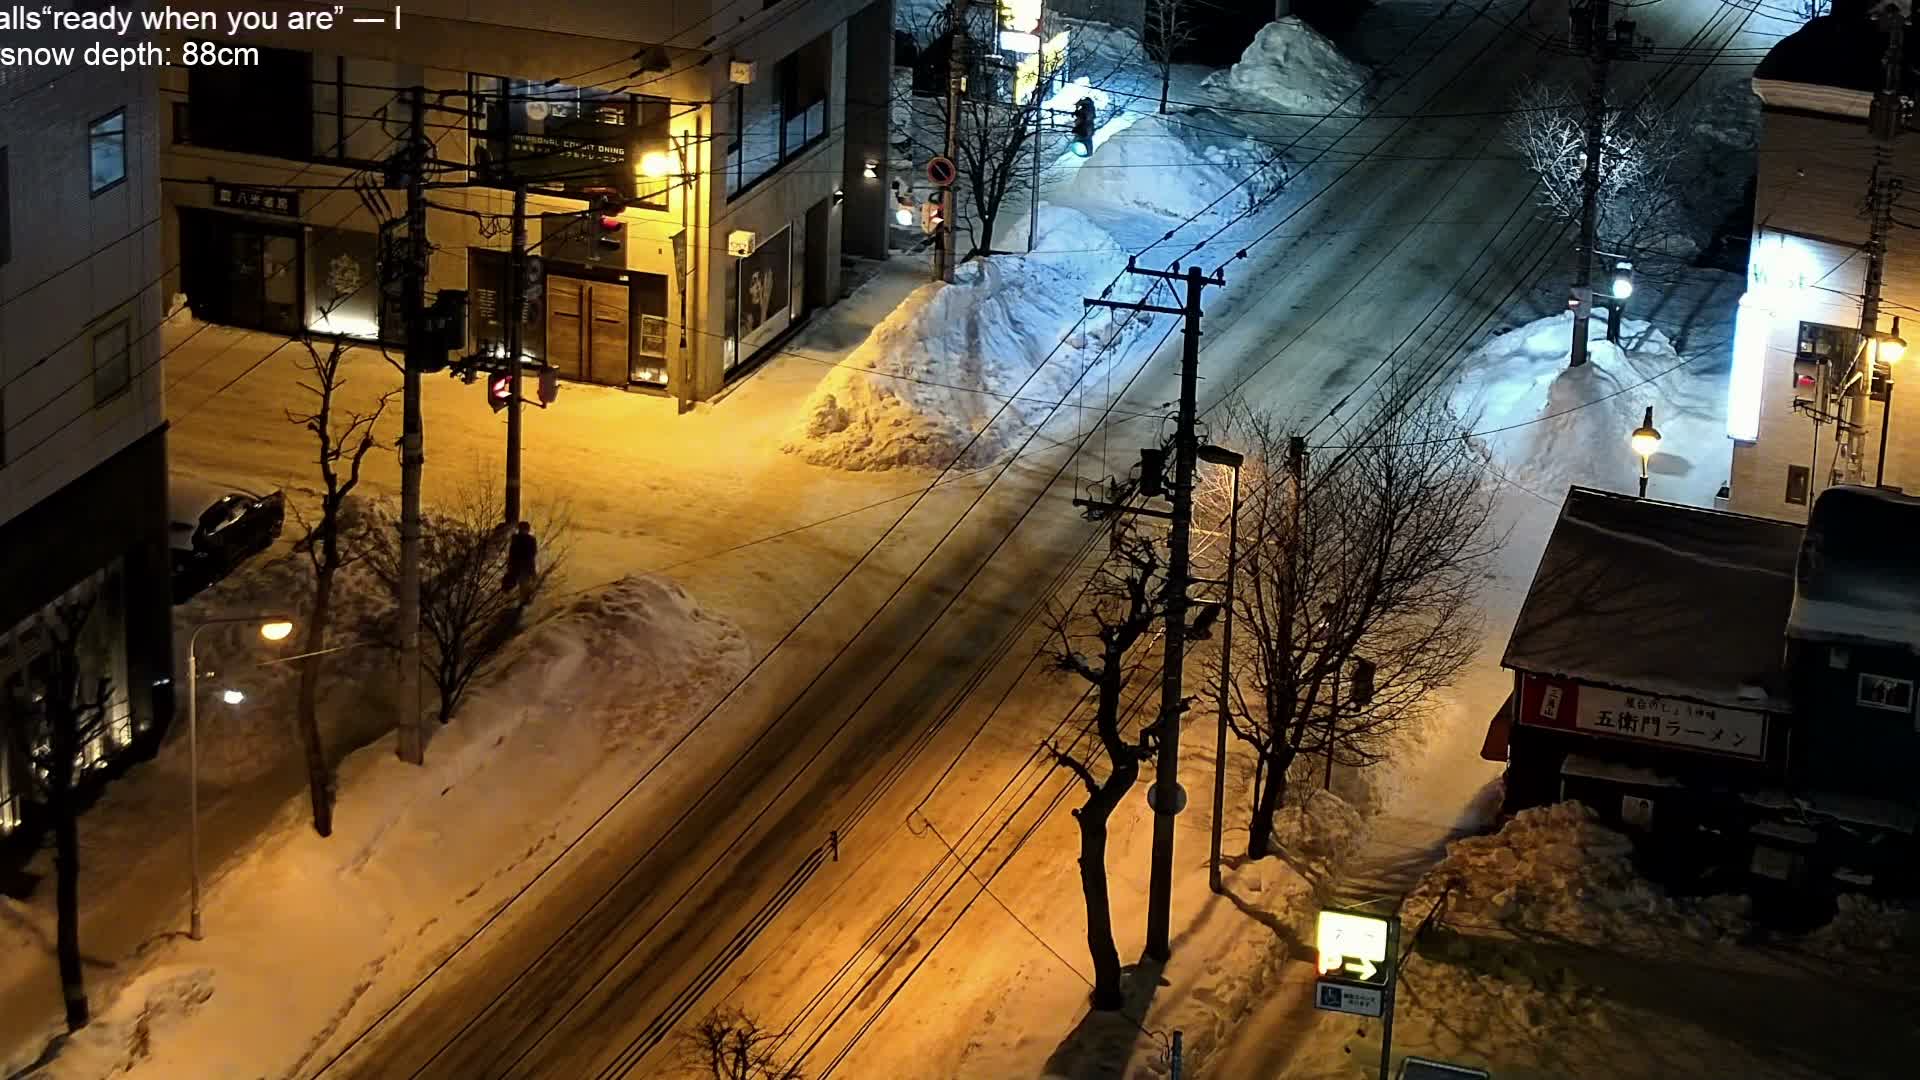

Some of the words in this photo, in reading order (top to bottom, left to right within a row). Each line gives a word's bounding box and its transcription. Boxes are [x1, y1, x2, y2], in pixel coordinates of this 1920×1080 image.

[1593, 709, 1747, 747] 五衛門ラーメン
